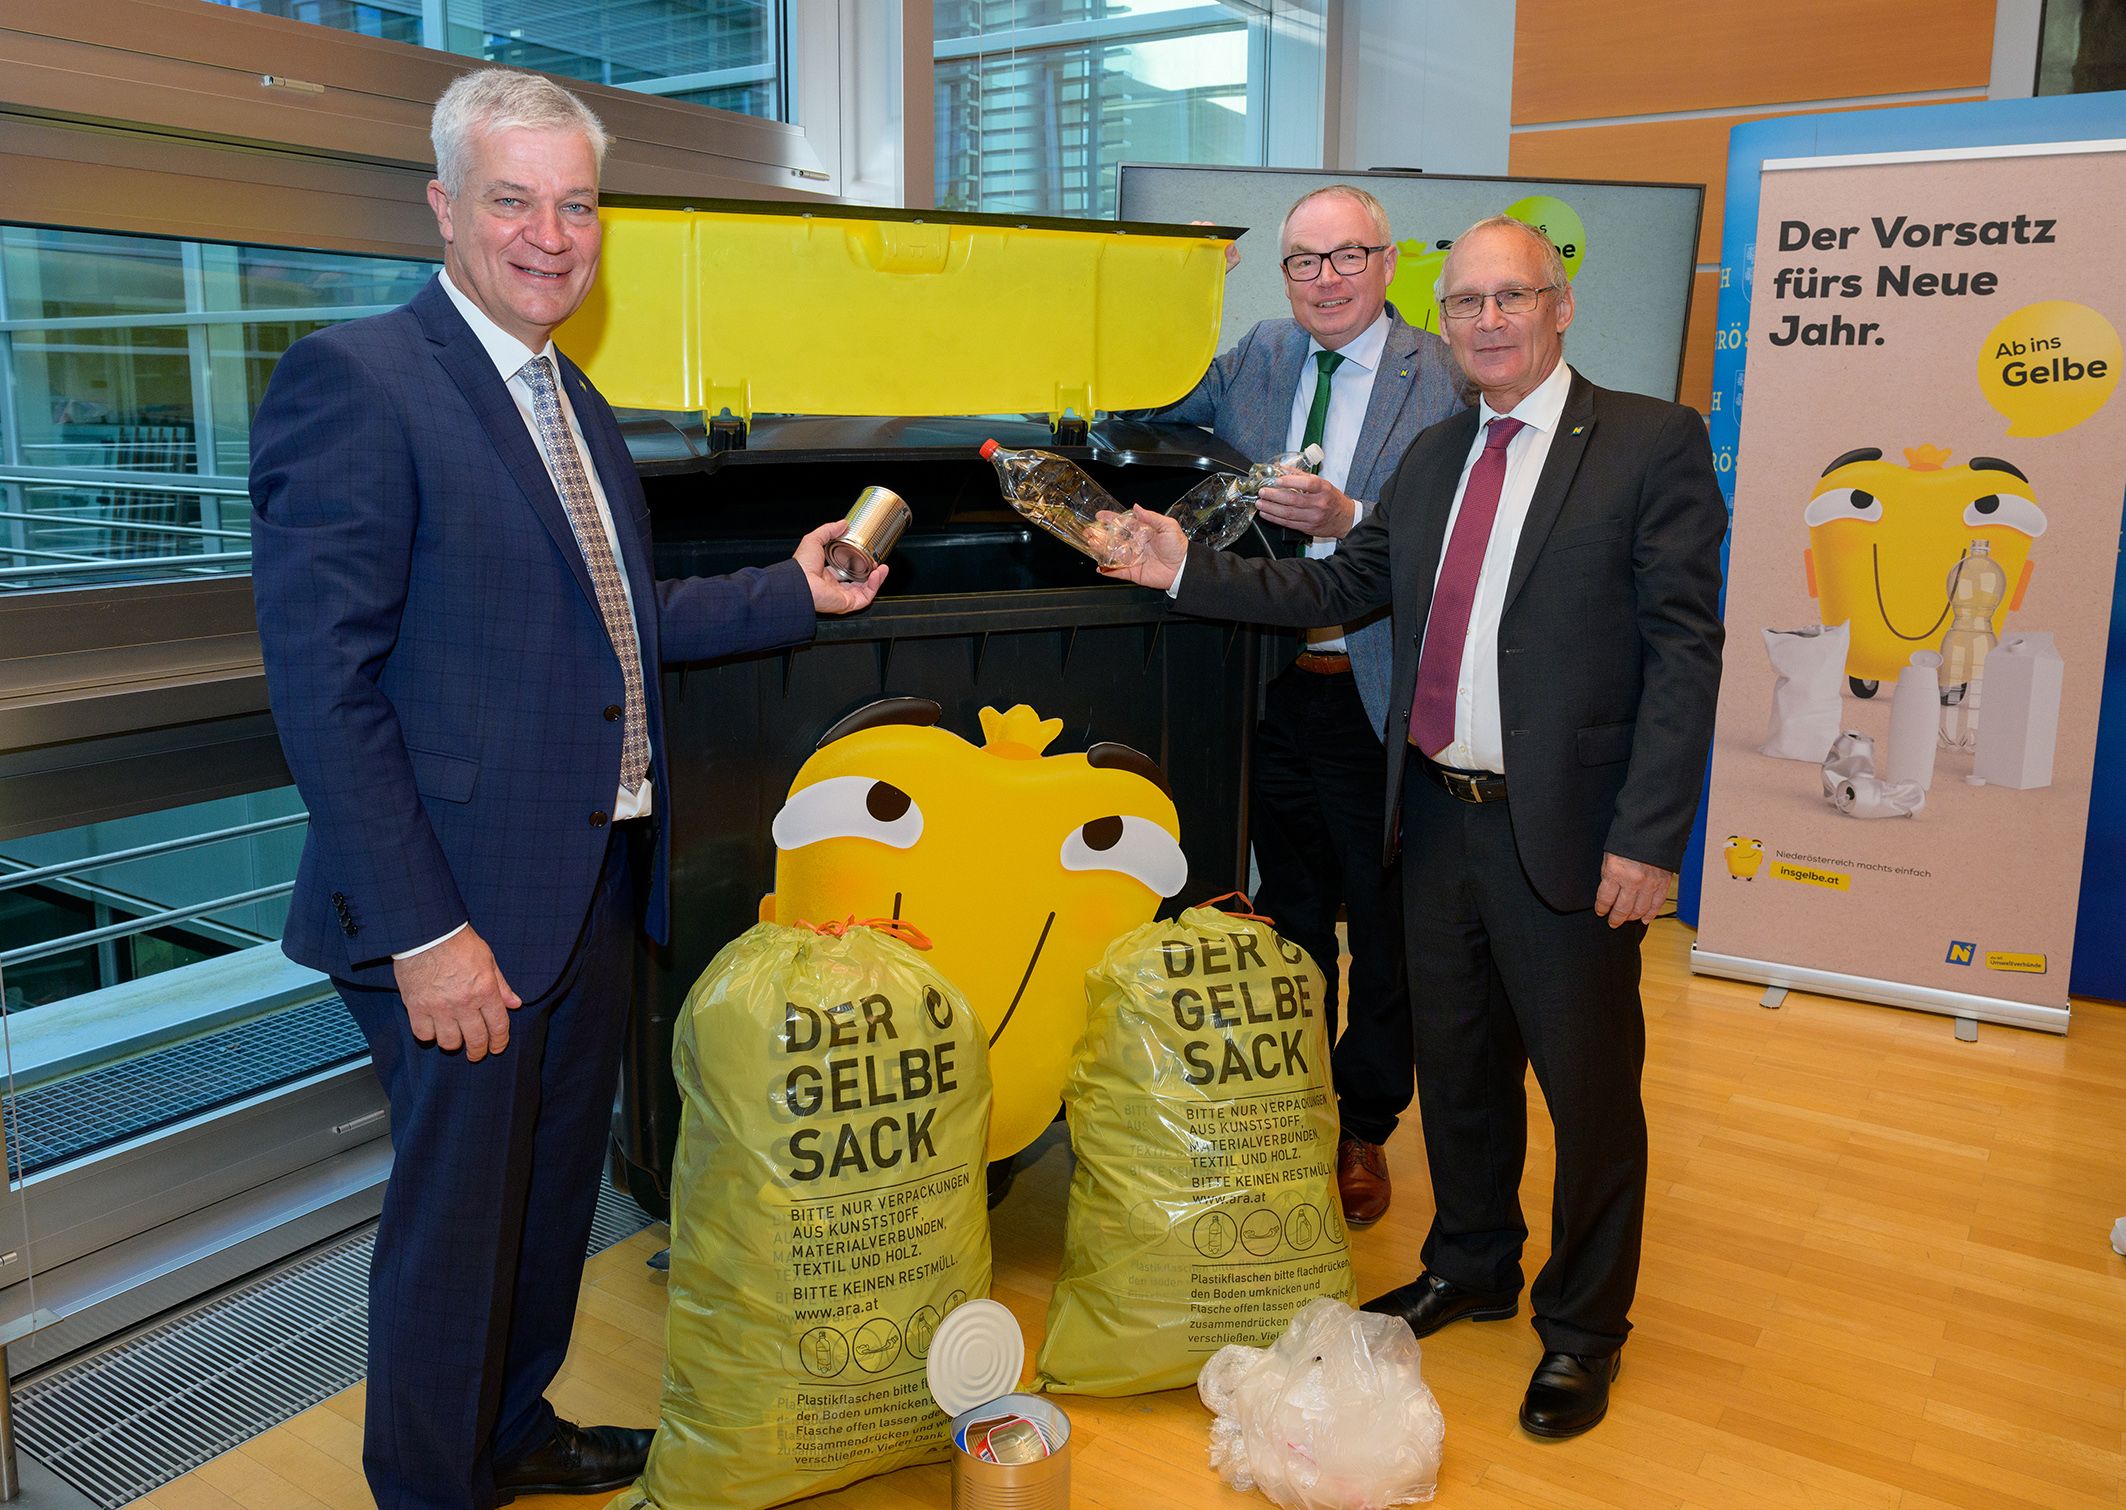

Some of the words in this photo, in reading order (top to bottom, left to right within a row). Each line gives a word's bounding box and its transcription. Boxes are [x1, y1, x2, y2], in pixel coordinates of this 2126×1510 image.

[1778, 220, 1861, 252] Der
[1871, 214, 2058, 249] Vorsatz
[1773, 266, 1863, 300] fürs
[1876, 265, 1999, 298] Neue
[1769, 315, 1886, 347] Jahr.
[1995, 341, 2027, 359] Ab
[2031, 334, 2062, 354] ins
[2001, 357, 2108, 387] Gelbe
[1776, 850, 1855, 868] Niederösterreich
[1857, 862, 1892, 873] machts
[1895, 867, 1932, 878] einfach
[1780, 866, 1840, 885] insgelbe.at
[1161, 933, 1266, 979] DER
[1172, 974, 1314, 1032] GELBE
[786, 993, 898, 1053] DER
[1183, 1029, 1309, 1085] SACK
[786, 1041, 957, 1117] GELBE
[1187, 1108, 1225, 1120] BITTE
[1230, 1104, 1257, 1117] NUR
[1189, 1122, 1216, 1135] AUS
[1220, 1114, 1304, 1134] KUNSTSTOFF,
[789, 1107, 937, 1181] SACK
[1190, 1155, 1237, 1168] TEXTIL
[1241, 1152, 1267, 1166] UND
[1271, 1147, 1301, 1162] HOLZ.
[1192, 1175, 1230, 1188] BITTE
[1235, 1171, 1280, 1187] KEINEN
[791, 1205, 835, 1221] BITTE
[842, 1200, 872, 1217] NUR
[878, 1172, 970, 1209] VERPACKUNGEN
[1192, 1191, 1266, 1205] www.ara.at
[792, 1225, 824, 1239] AUS
[792, 1217, 947, 1258] MATERIALVERBUNDEN,
[793, 1261, 846, 1276] TEXTIL
[851, 1253, 880, 1270] UND
[886, 1244, 922, 1264] HOLZ.
[793, 1284, 838, 1300] BITTE
[843, 1273, 895, 1295] KEINEN
[899, 1253, 959, 1284] RESTMÜLL.
[1191, 1272, 1271, 1284] Plastikflaschen
[1274, 1270, 1295, 1281] bitte
[1191, 1288, 1210, 1299] den
[1213, 1288, 1246, 1299] Boden
[1249, 1283, 1301, 1297] umknicken
[1303, 1279, 1320, 1291] und
[794, 1298, 879, 1320] www.ara.at
[1190, 1303, 1232, 1315] Flasche
[1234, 1301, 1260, 1313] offen
[1262, 1299, 1294, 1312] lassen
[1190, 1317, 1289, 1329] zusammendrücken
[1188, 1333, 1258, 1344] verschließen.
[1261, 1332, 1281, 1341] Viel
[797, 1389, 890, 1406] Plastikflaschen
[893, 1383, 918, 1397] bitte
[797, 1411, 818, 1421] den
[823, 1409, 861, 1421] Boden
[864, 1397, 928, 1416] umknicken
[795, 1429, 909, 1450] zusammendrücken
[913, 1423, 934, 1434] und
[796, 1424, 842, 1436] Flasche
[846, 1421, 876, 1433] offen
[879, 1415, 918, 1428] lassen
